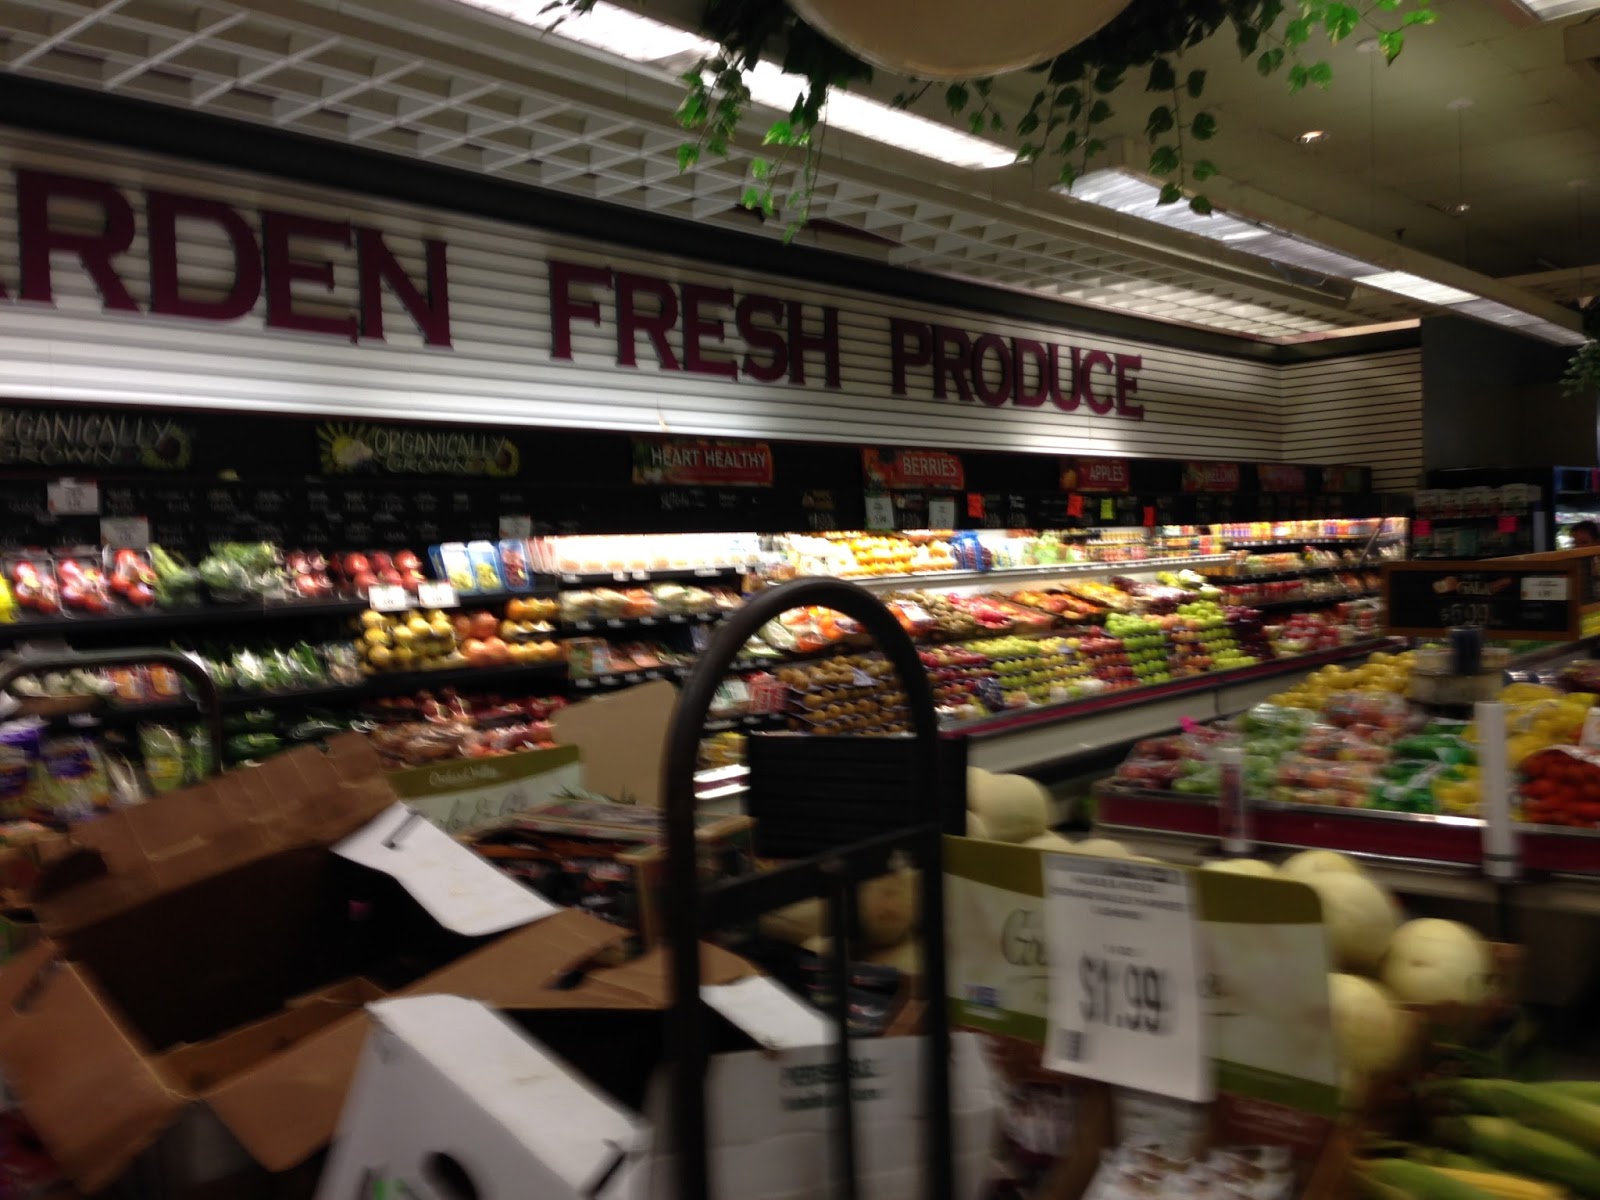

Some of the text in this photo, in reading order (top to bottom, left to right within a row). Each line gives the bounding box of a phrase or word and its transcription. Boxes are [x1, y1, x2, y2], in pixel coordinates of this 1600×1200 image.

[0, 170, 1145, 421] RDEN FRESH PRODUCE
[375, 428, 506, 458] ORGANICALLY
[651, 447, 768, 469] HEART HEALTHY
[902, 456, 957, 477] BERRIES
[1089, 464, 1125, 482] APPLES
[1078, 954, 1166, 1034] $1.99
